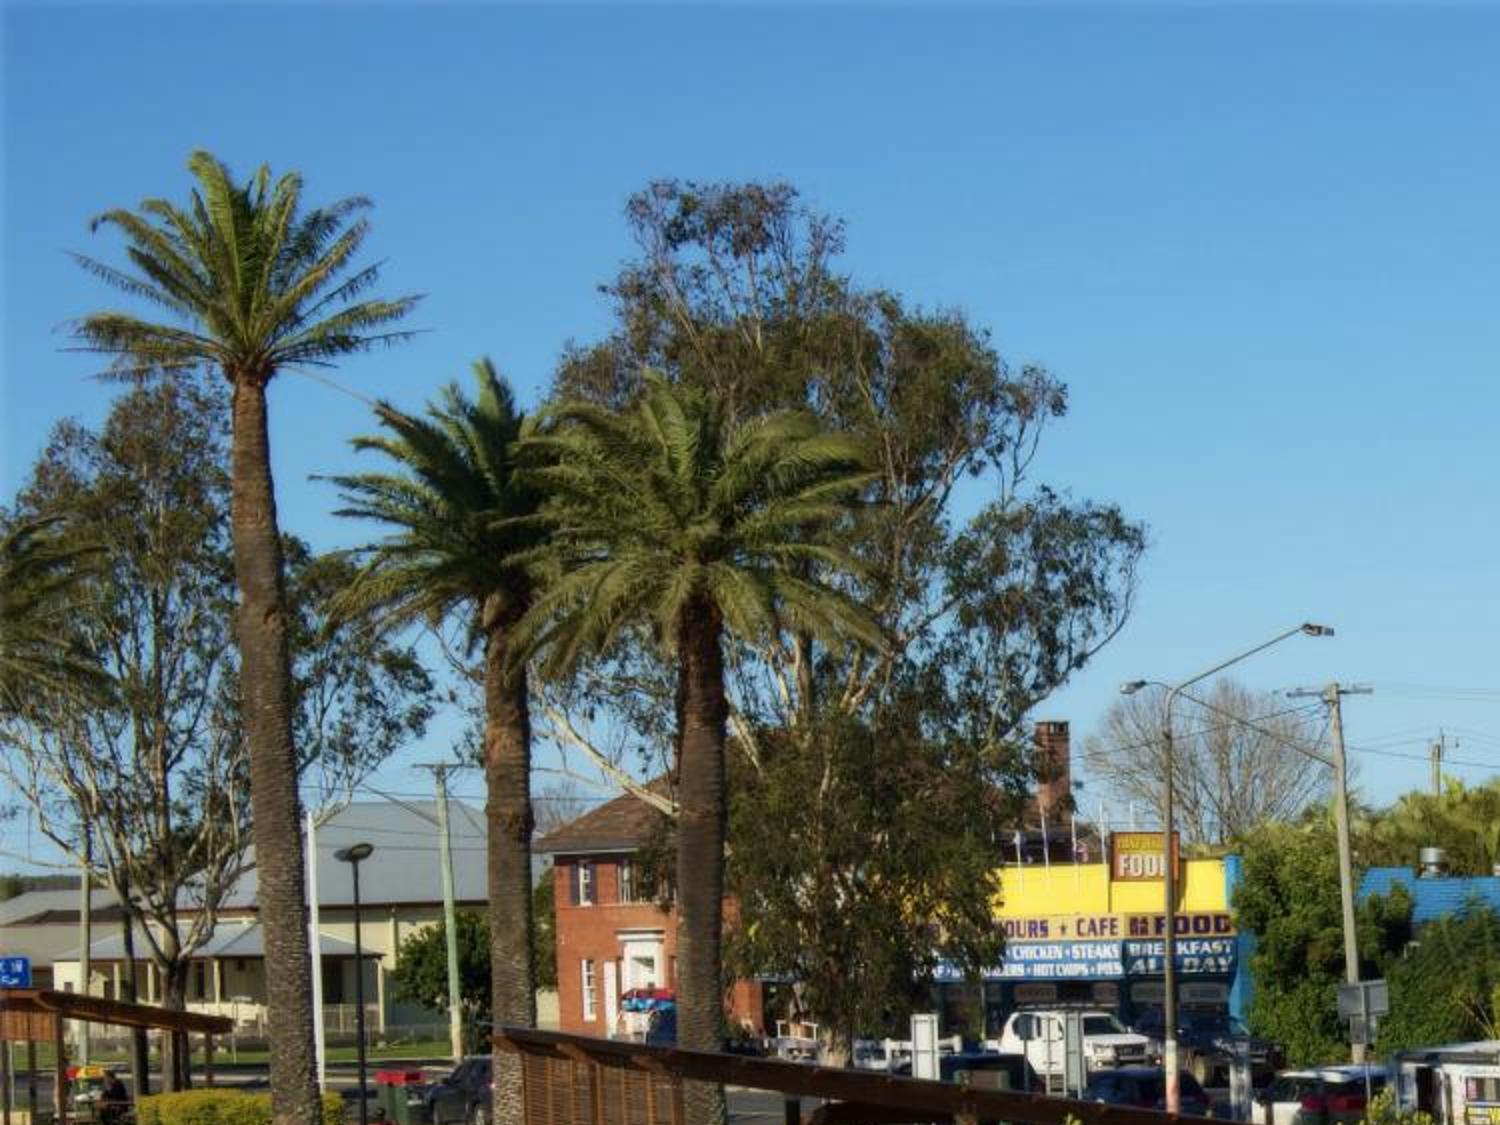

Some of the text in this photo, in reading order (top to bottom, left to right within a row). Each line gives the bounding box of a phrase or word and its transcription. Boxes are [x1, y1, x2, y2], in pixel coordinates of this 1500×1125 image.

[1076, 917, 1118, 937] CAFE
[1154, 914, 1232, 937] FOOD
[1012, 944, 1120, 961] CHICKEN STEAKS
[1129, 940, 1233, 956] BREKFAST
[1033, 964, 1055, 976] HOT
[1183, 956, 1233, 973] DAY
